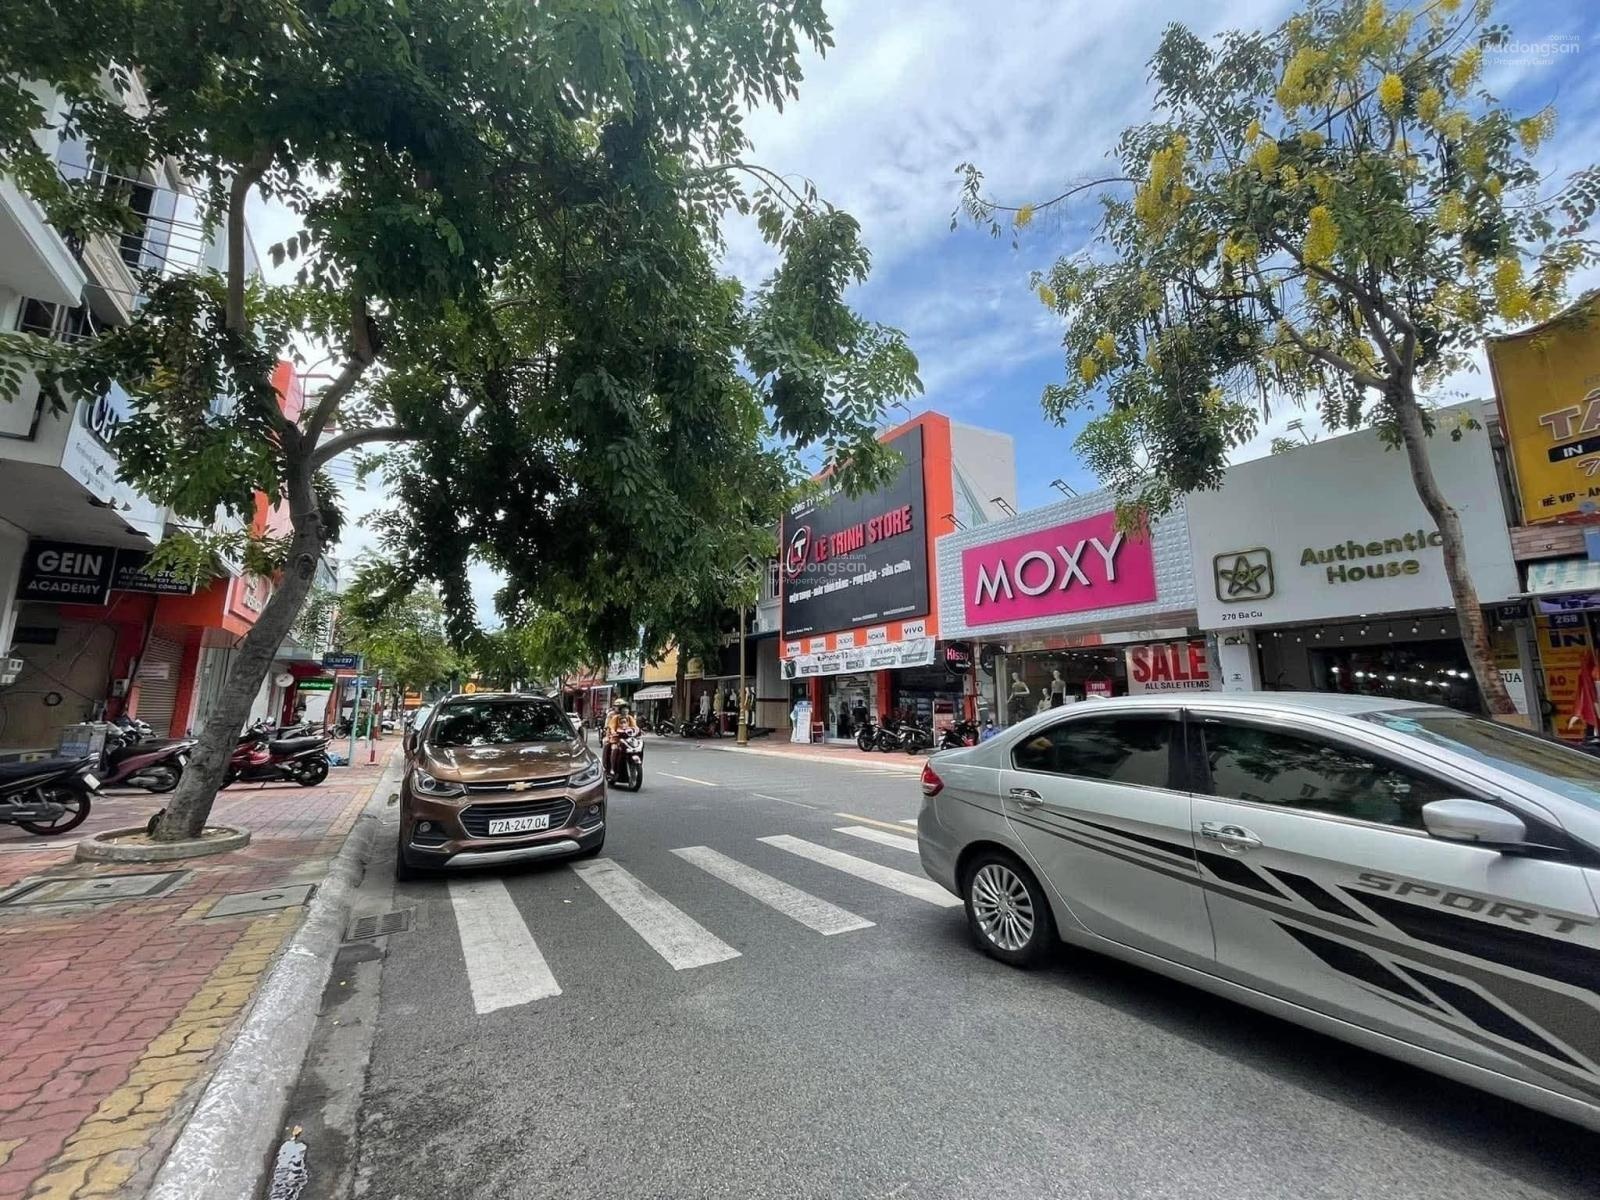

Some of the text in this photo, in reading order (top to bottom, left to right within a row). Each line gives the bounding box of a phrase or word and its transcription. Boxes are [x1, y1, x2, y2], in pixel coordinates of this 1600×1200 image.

[1563, 444, 1584, 457] IN
[1558, 492, 1576, 503] VIP
[831, 523, 866, 558] TRỊNH
[868, 504, 914, 543] STORE
[1300, 528, 1444, 567] Authentic
[36, 550, 103, 577] GEIN
[974, 530, 1126, 606] MOXY
[1326, 558, 1421, 584] House
[27, 580, 101, 595] ACADEMY
[1222, 610, 1263, 621] 270 Ba Cu
[903, 625, 924, 635] VIVO
[1131, 640, 1209, 683] SALE
[1145, 680, 1210, 690] ALL SALE ITEMS
[1355, 871, 1597, 934] SPORT
